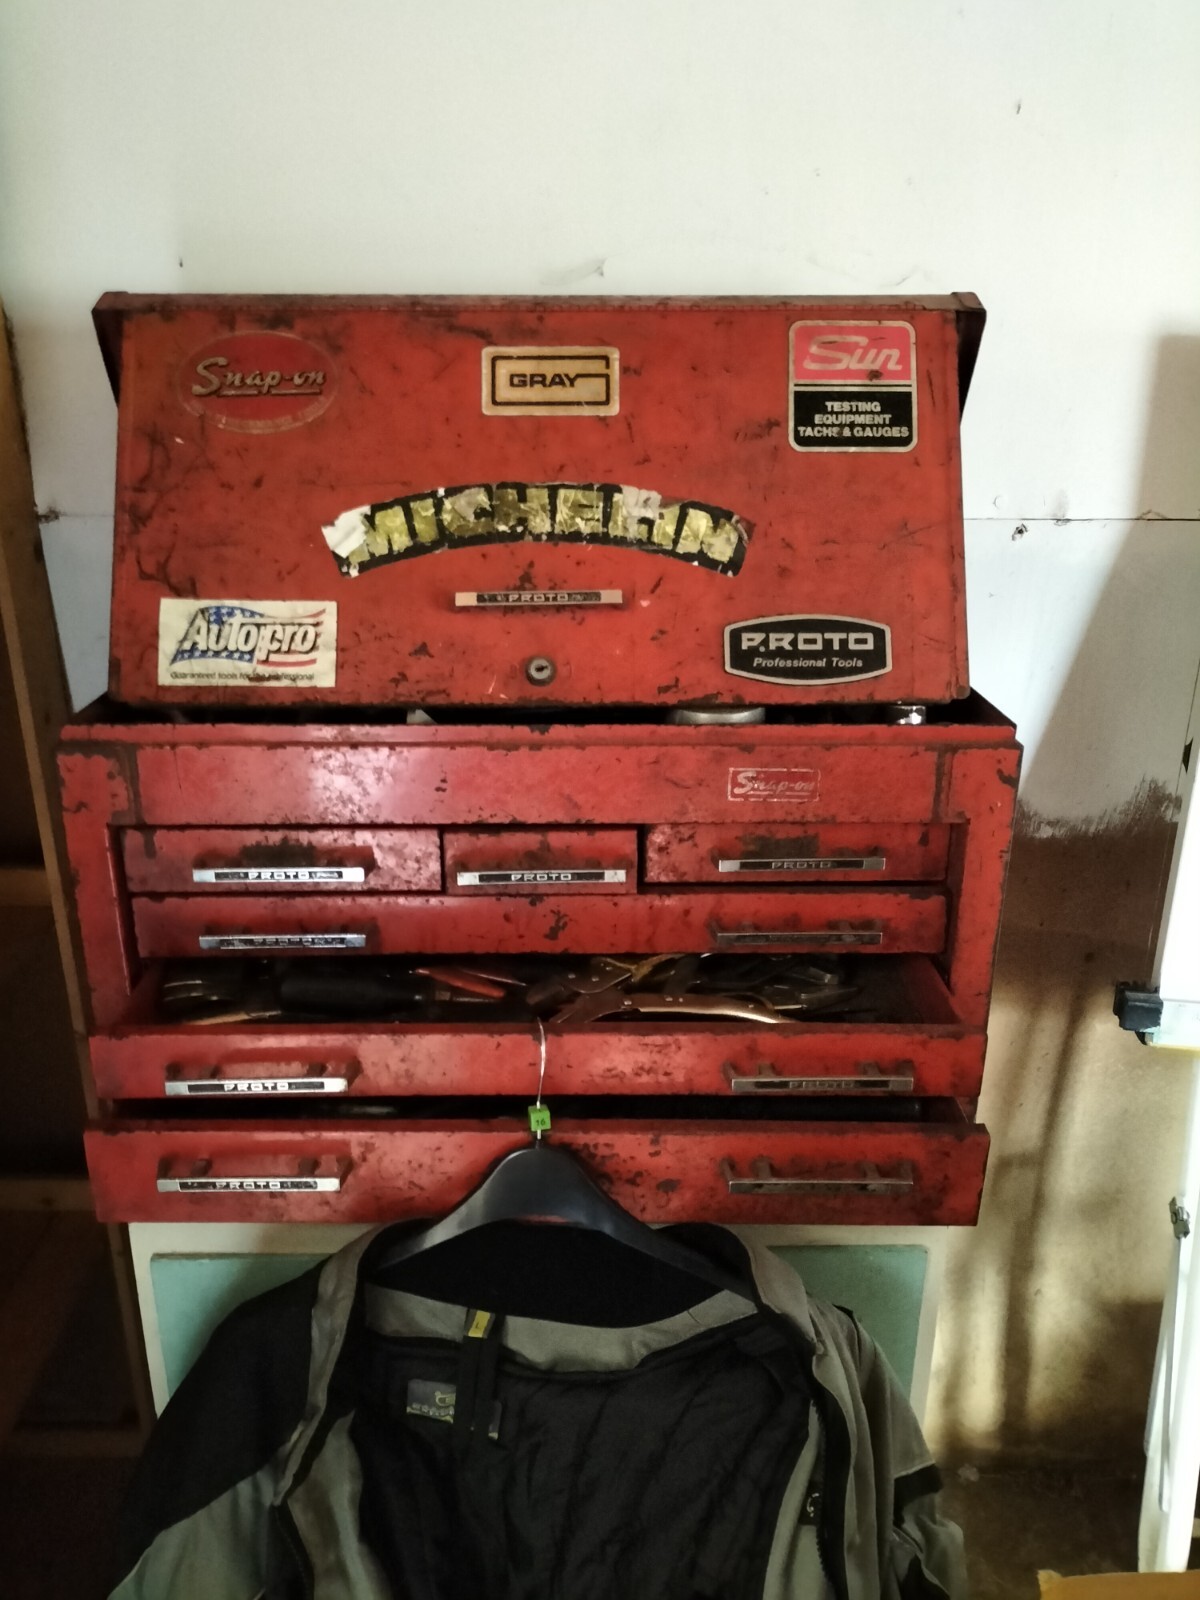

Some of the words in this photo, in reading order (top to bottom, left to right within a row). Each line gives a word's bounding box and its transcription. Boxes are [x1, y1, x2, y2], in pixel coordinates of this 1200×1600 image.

[803, 334, 903, 370] Sun
[191, 356, 327, 397] Snap-on
[509, 373, 579, 388] GRAY
[825, 401, 882, 412] TESTING
[814, 413, 892, 425] EQUIPMENT
[842, 427, 852, 437] &
[853, 426, 910, 438] GAUGES
[508, 593, 569, 602] PROTO
[753, 657, 826, 668] Professional
[831, 657, 864, 668] Tools
[771, 861, 832, 870] PROTO
[248, 871, 310, 880] PROTO
[510, 872, 572, 882] PROTO
[223, 1082, 289, 1092] PROTO
[215, 1180, 281, 1190] PROTO
